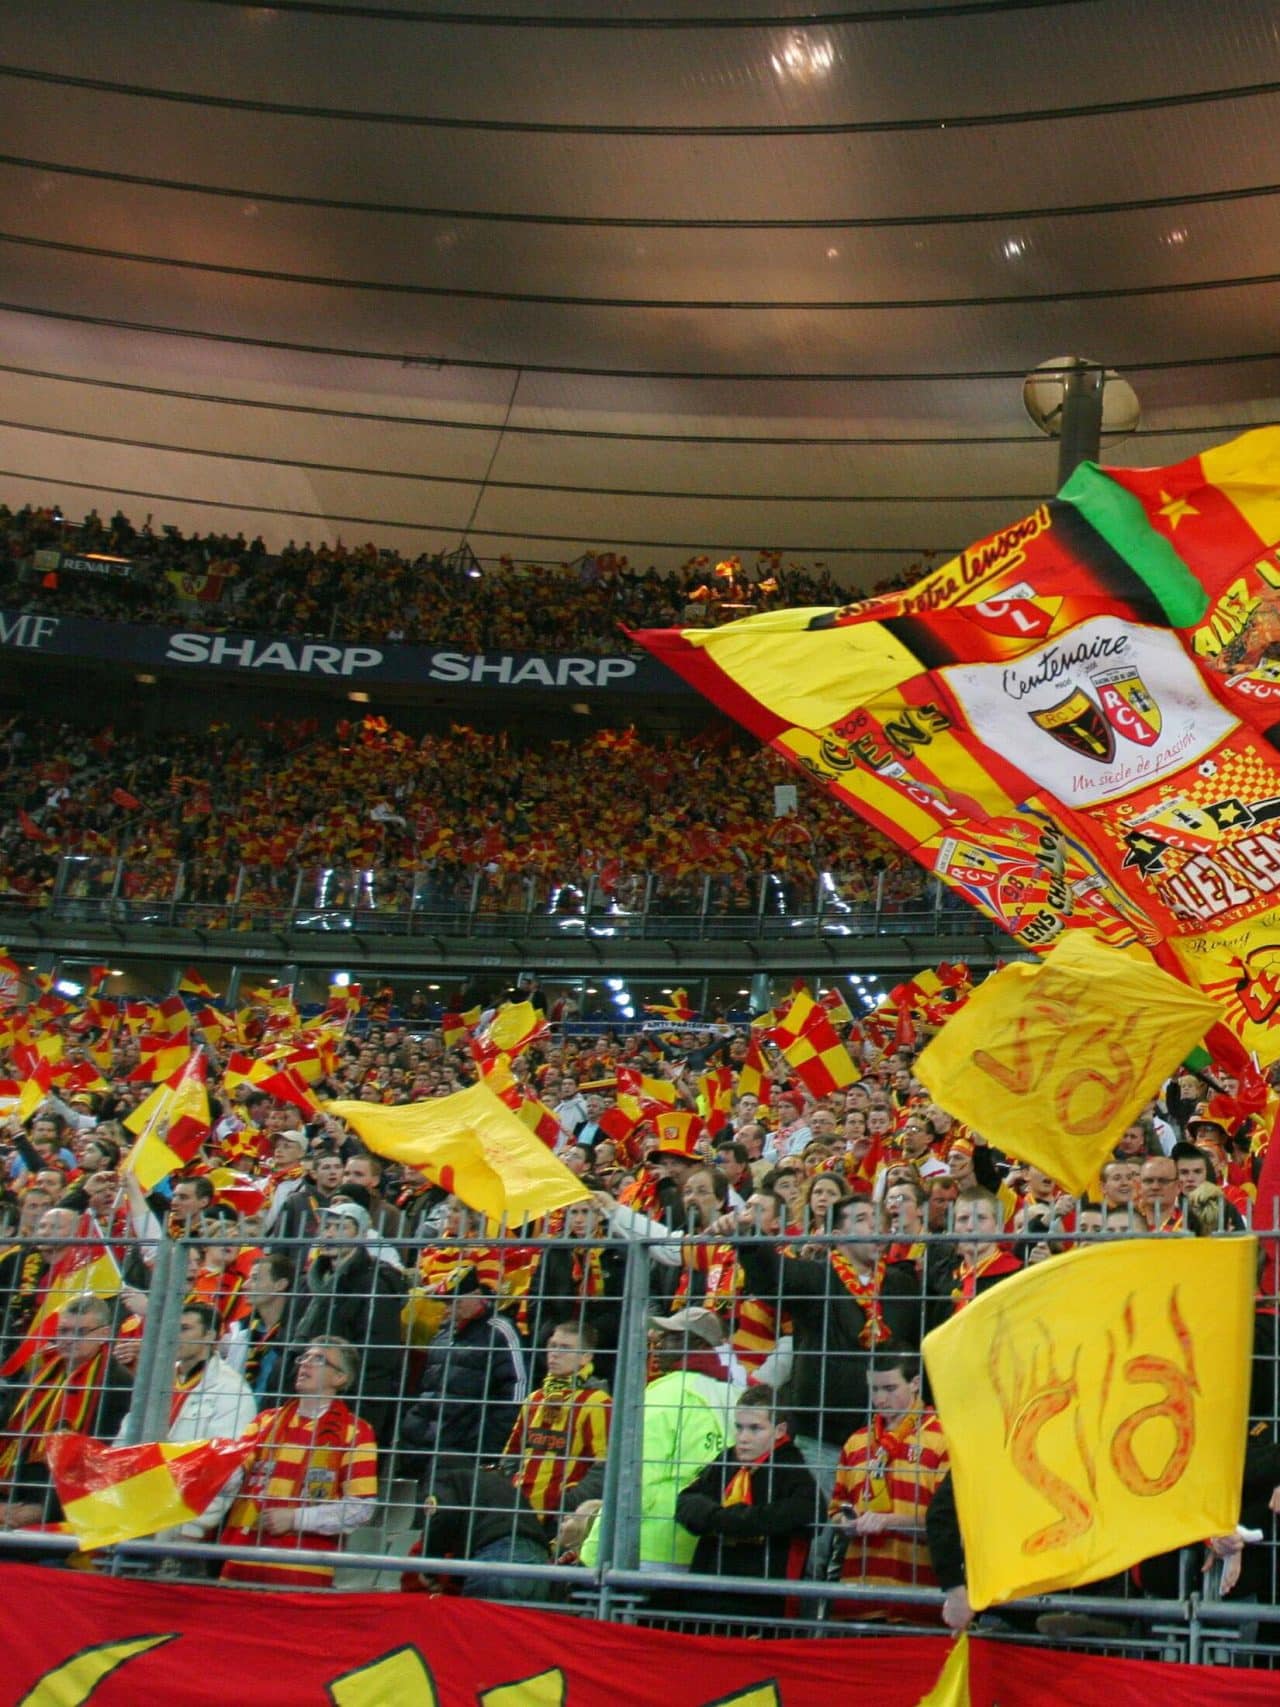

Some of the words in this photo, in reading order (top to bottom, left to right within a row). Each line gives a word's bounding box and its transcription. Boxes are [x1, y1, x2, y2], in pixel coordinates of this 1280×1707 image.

[165, 633, 383, 676] SHARP
[429, 652, 637, 686] SHARP
[1046, 702, 1084, 724] RCL
[1103, 690, 1151, 740] RCL
[951, 867, 995, 882] RCL
[1019, 910, 1057, 944] LENS
